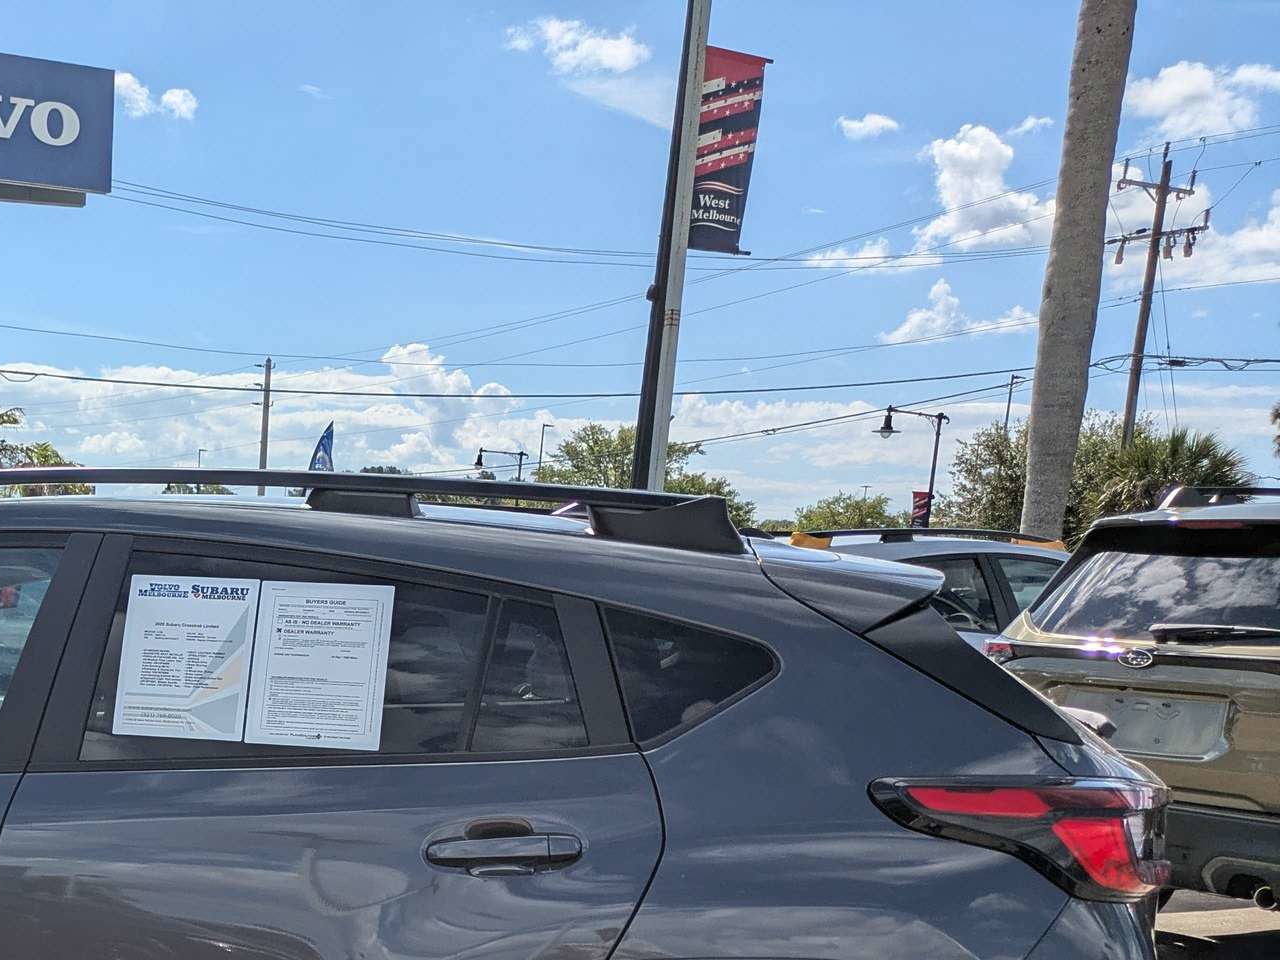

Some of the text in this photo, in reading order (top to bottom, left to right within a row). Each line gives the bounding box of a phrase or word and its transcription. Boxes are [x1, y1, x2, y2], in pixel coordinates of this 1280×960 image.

[699, 194, 730, 209] West
[149, 583, 180, 591] VOLVO
[191, 584, 250, 596] SUBARU
[138, 589, 189, 598] MELBOURNE
